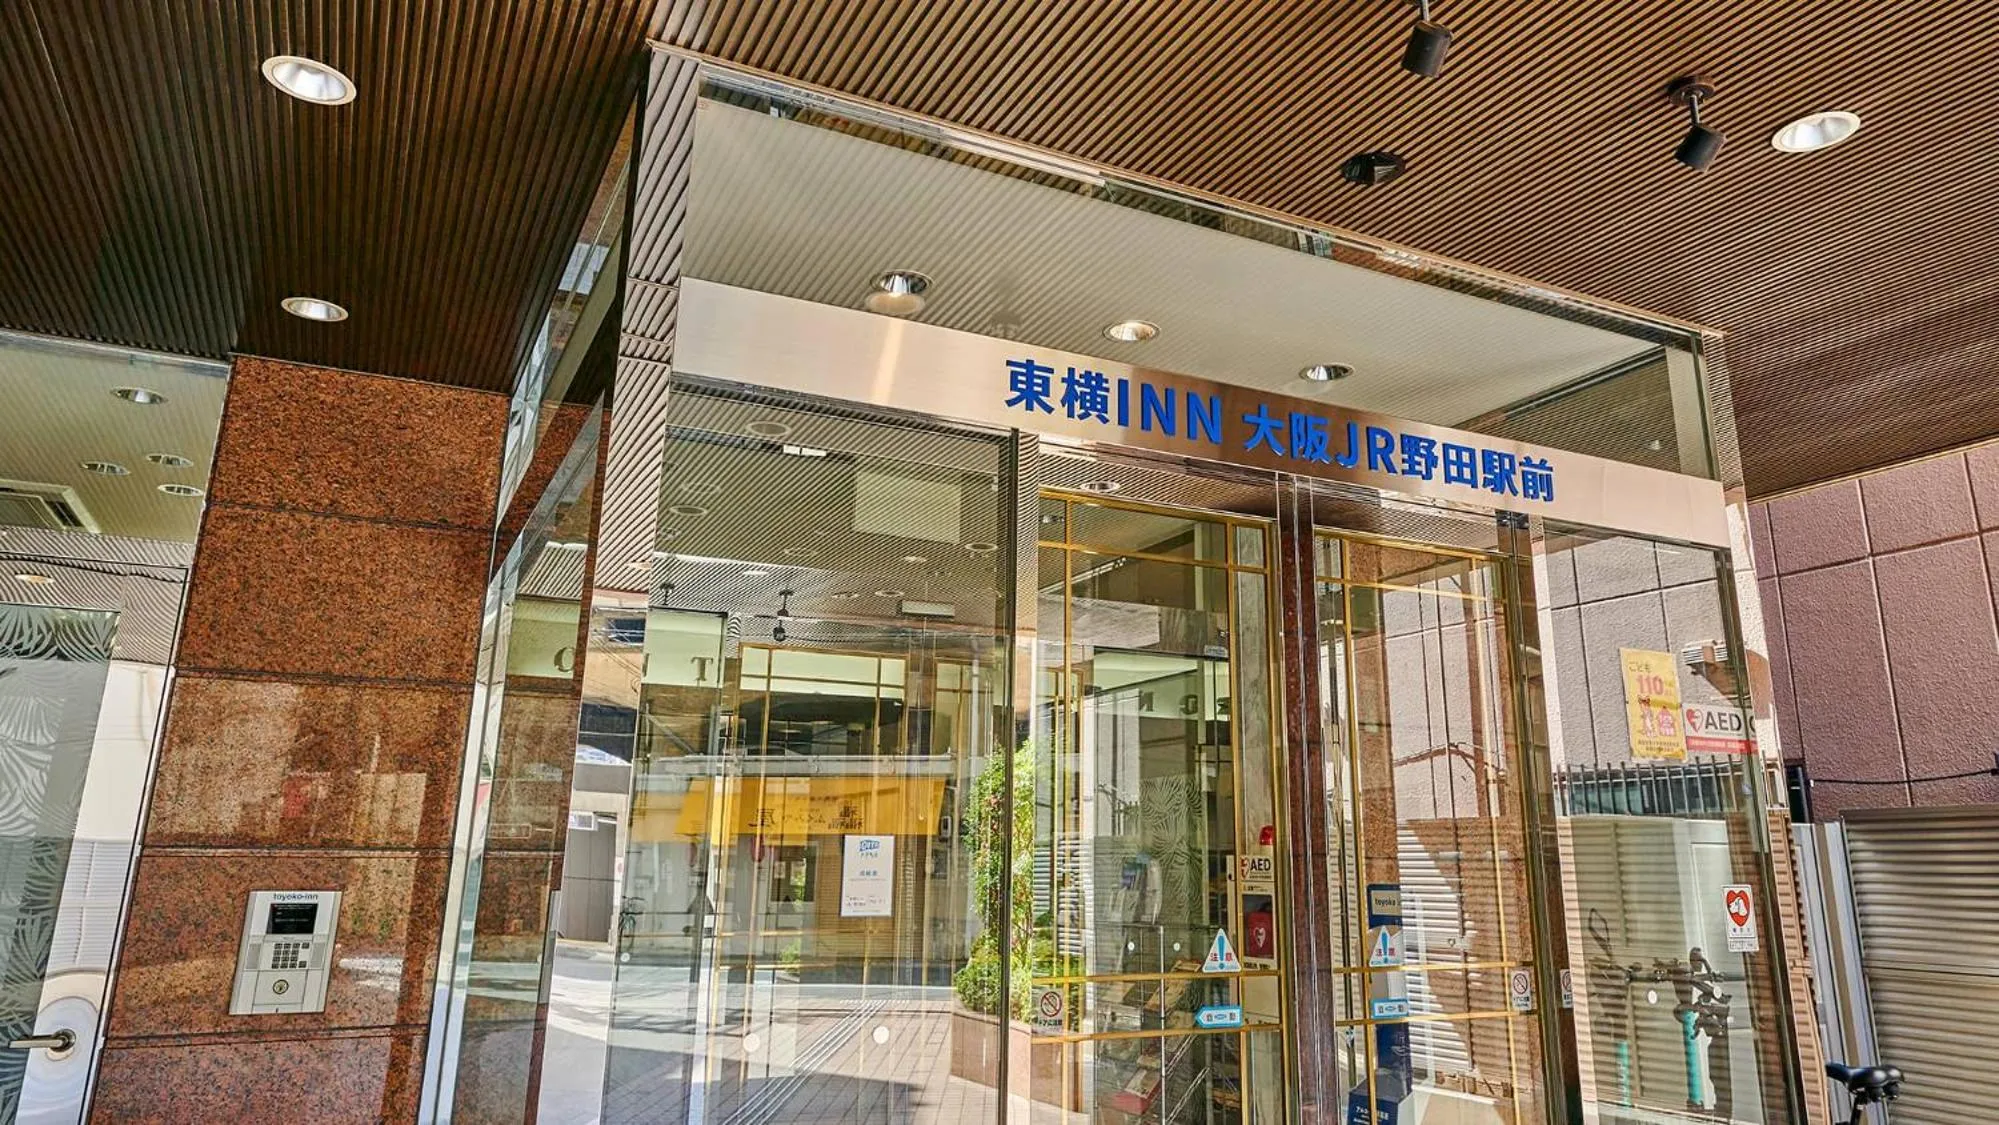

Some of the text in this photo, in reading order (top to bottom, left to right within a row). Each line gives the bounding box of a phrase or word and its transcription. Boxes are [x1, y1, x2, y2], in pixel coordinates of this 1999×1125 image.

[1004, 359, 1556, 502] 東横INN 大阪JR野田駅前
[1636, 674, 1664, 696] 110
[1704, 710, 1743, 733] AED
[1250, 858, 1271, 871] AED
[273, 893, 318, 901] toyoko-inn
